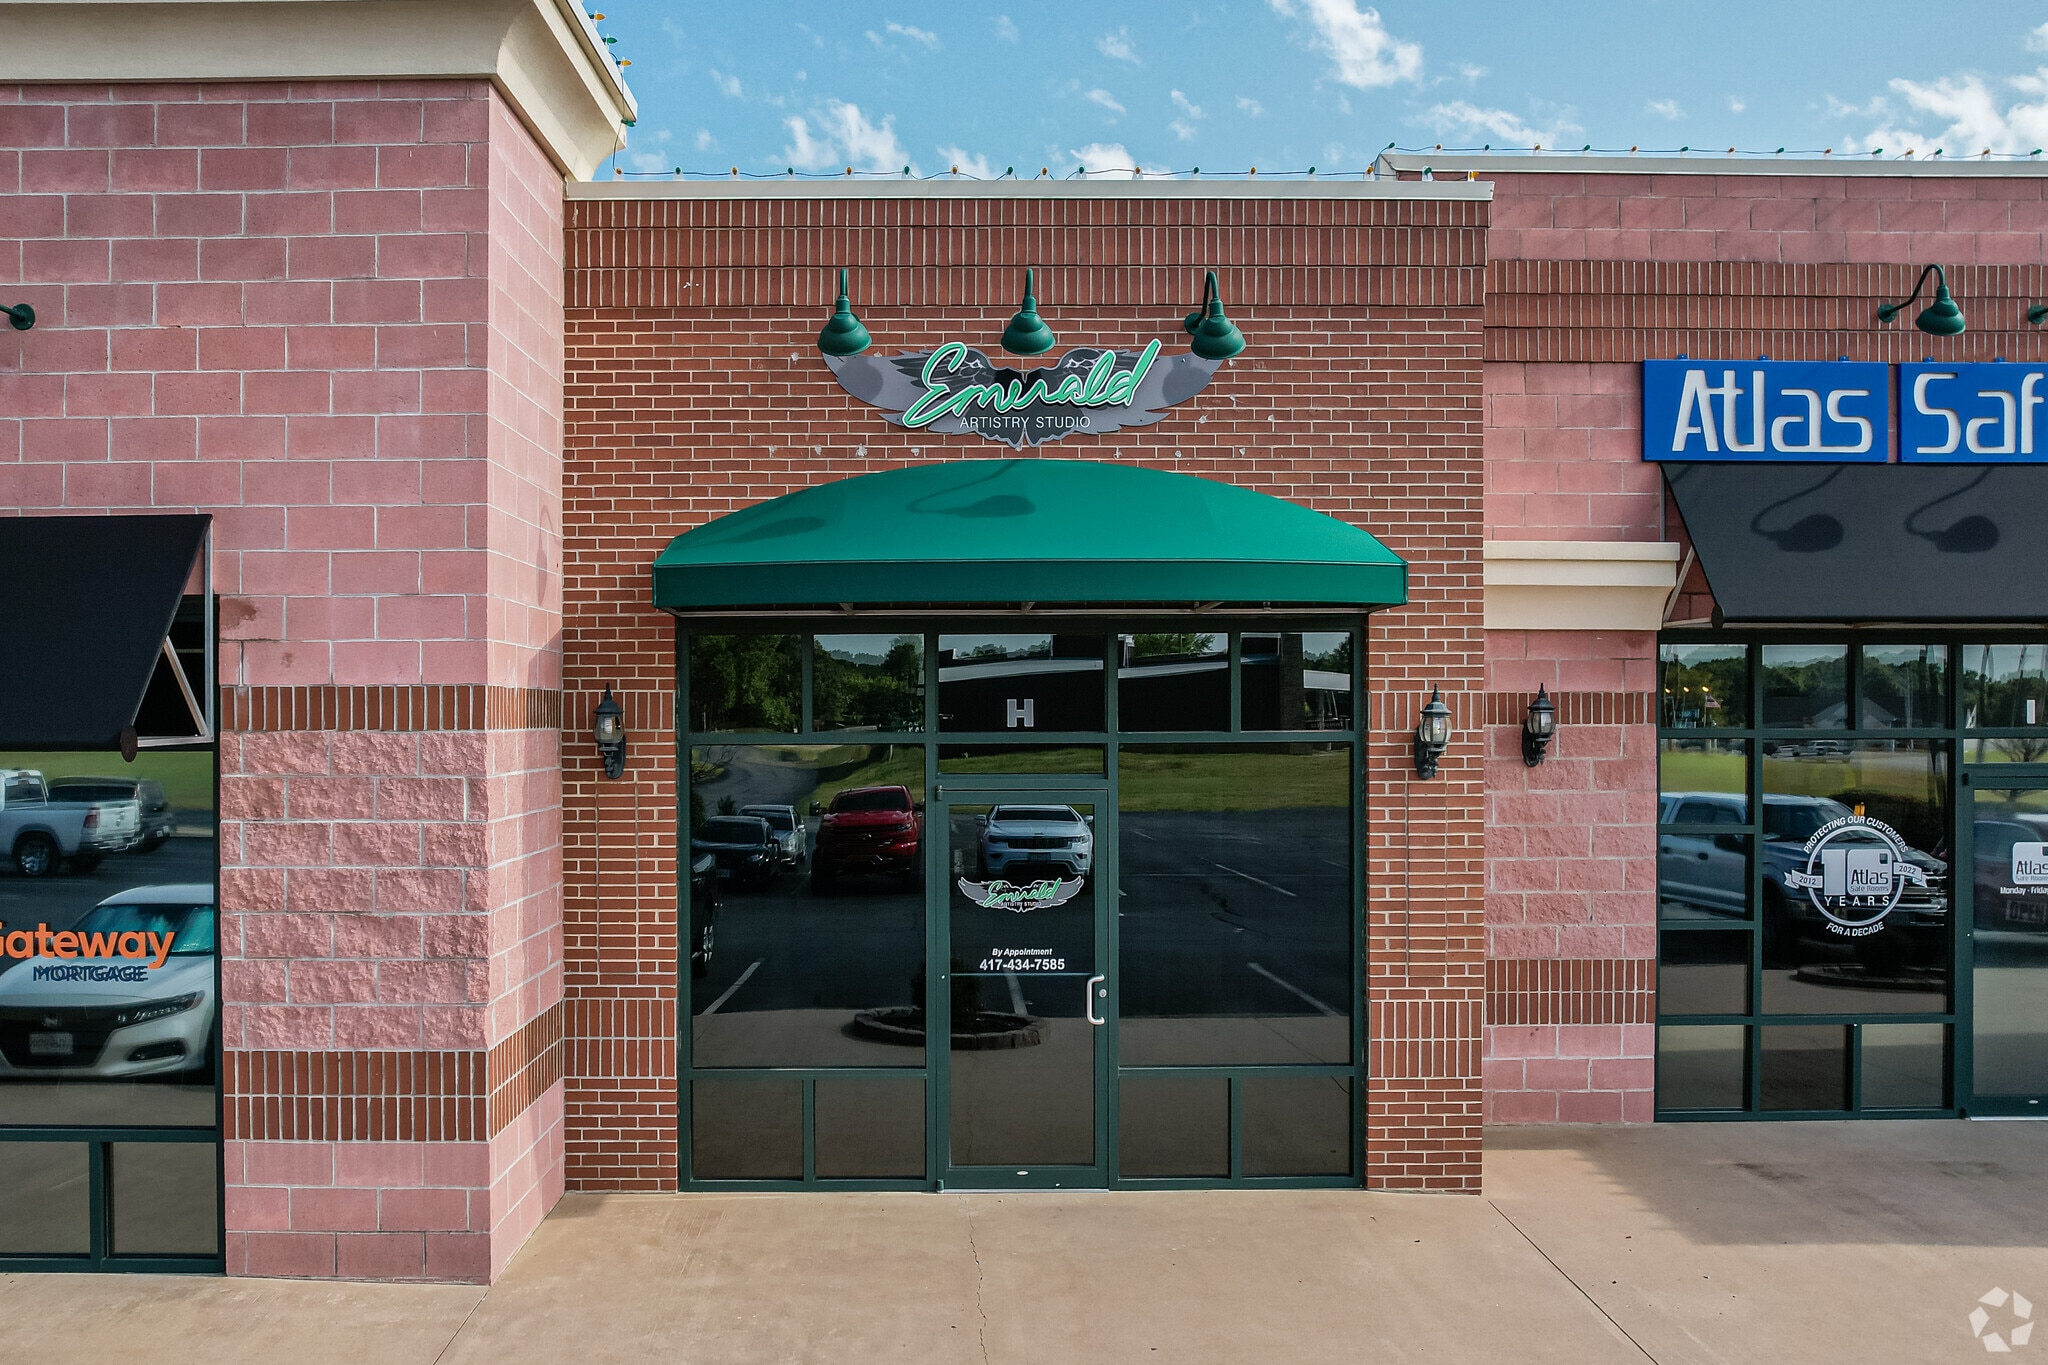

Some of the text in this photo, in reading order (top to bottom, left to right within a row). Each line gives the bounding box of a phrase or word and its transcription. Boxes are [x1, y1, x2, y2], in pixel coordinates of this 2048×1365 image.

[902, 338, 1162, 428] Emerald
[1671, 370, 1873, 453] Atlas
[959, 416, 1091, 429] ARTISTRY STUDIO
[1006, 698, 1034, 728] H
[1803, 815, 1909, 854] PROTECTING OUR CUSTOMERS
[1851, 869, 1889, 885] Atlas
[1899, 865, 1917, 875] 2022
[1799, 875, 1817, 885] 2012
[983, 877, 1062, 907] Emerald
[2000, 886, 2026, 896] Monday
[1824, 896, 1890, 907] YEARS
[1825, 921, 1885, 937] FOR A DECADE
[0, 922, 176, 970] ateway
[992, 948, 1053, 957] By Appointment
[979, 958, 1065, 971] 417-434-7585
[33, 965, 149, 982] MORTGAGE
